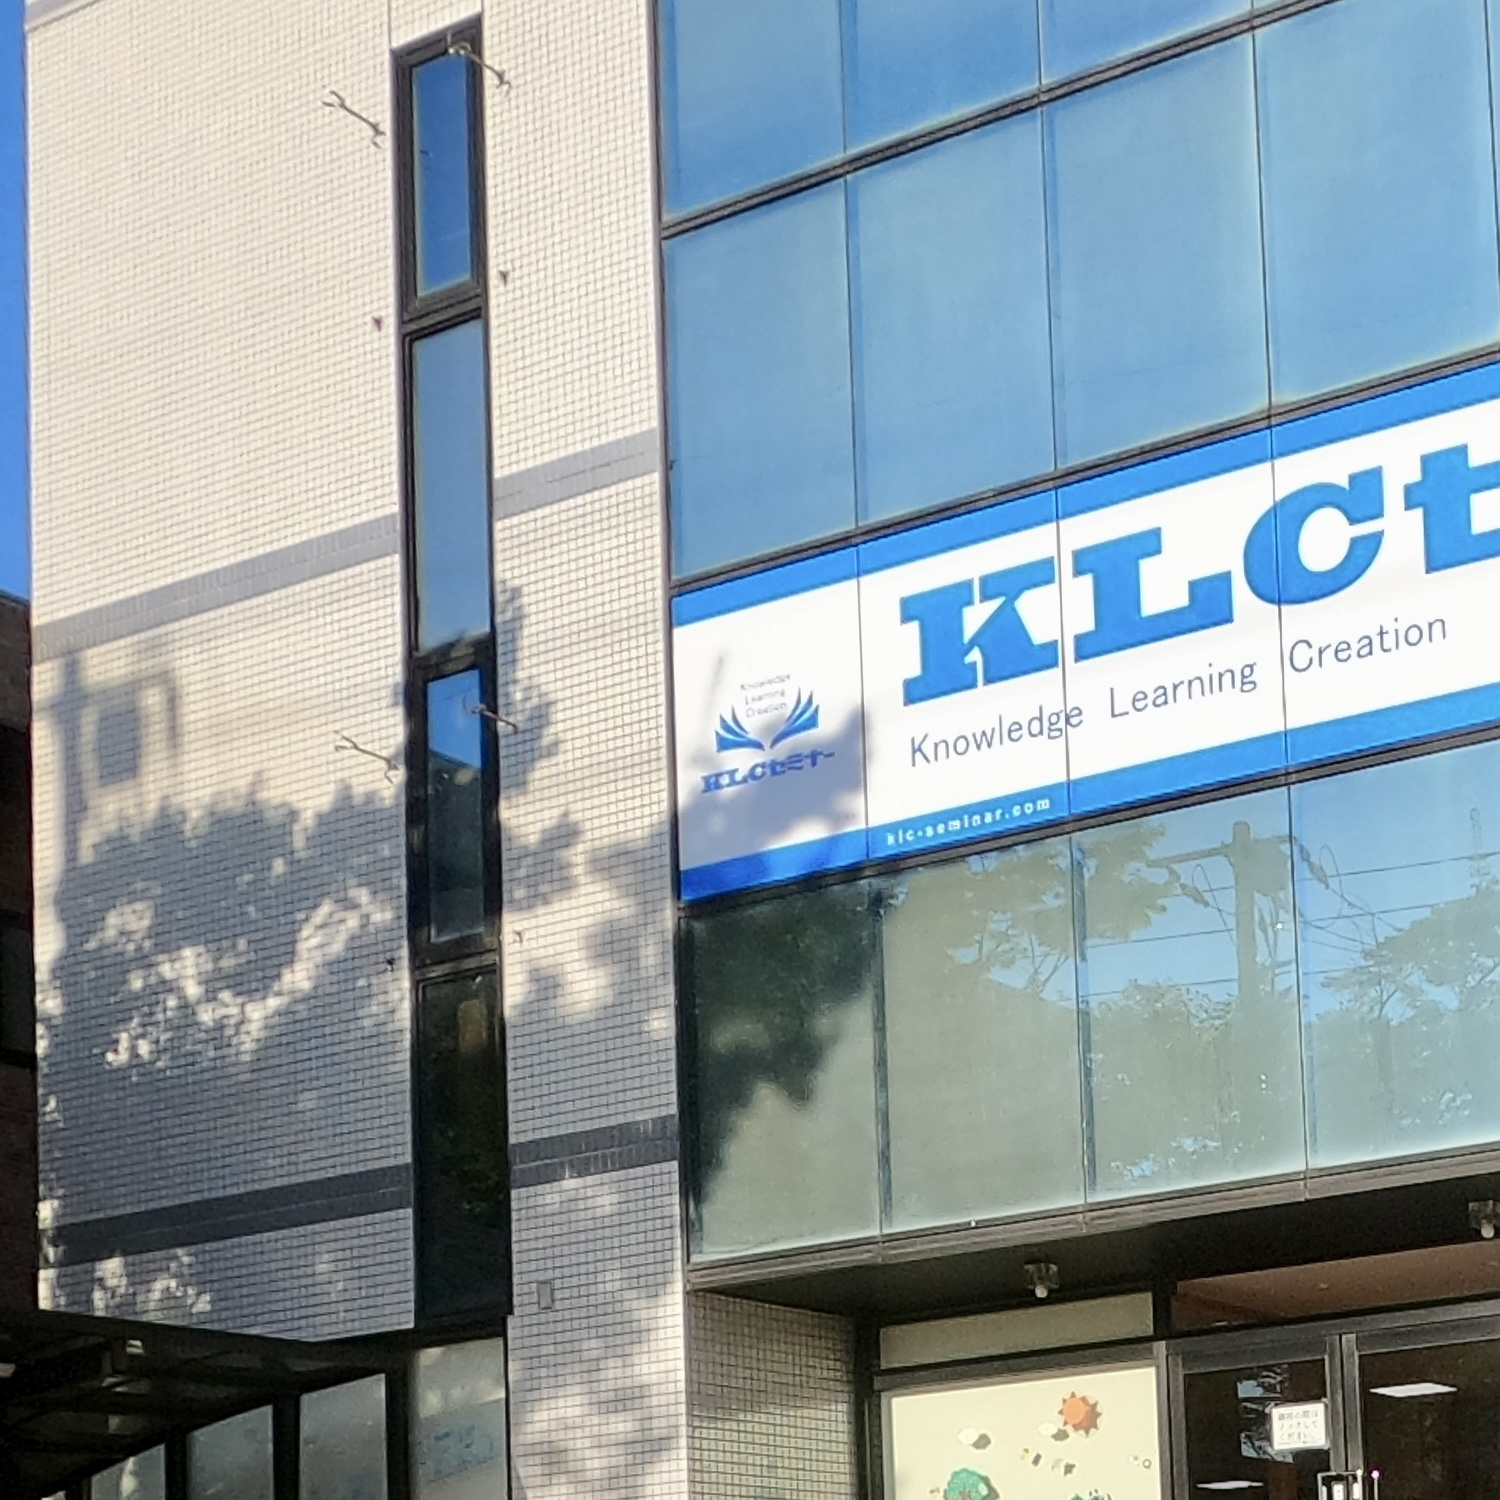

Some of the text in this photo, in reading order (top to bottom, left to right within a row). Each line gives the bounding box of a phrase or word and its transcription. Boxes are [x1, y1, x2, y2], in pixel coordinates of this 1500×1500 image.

[909, 612, 1448, 768] Knowledge Learning Creation
[886, 797, 1051, 847] klc-seminar.com
